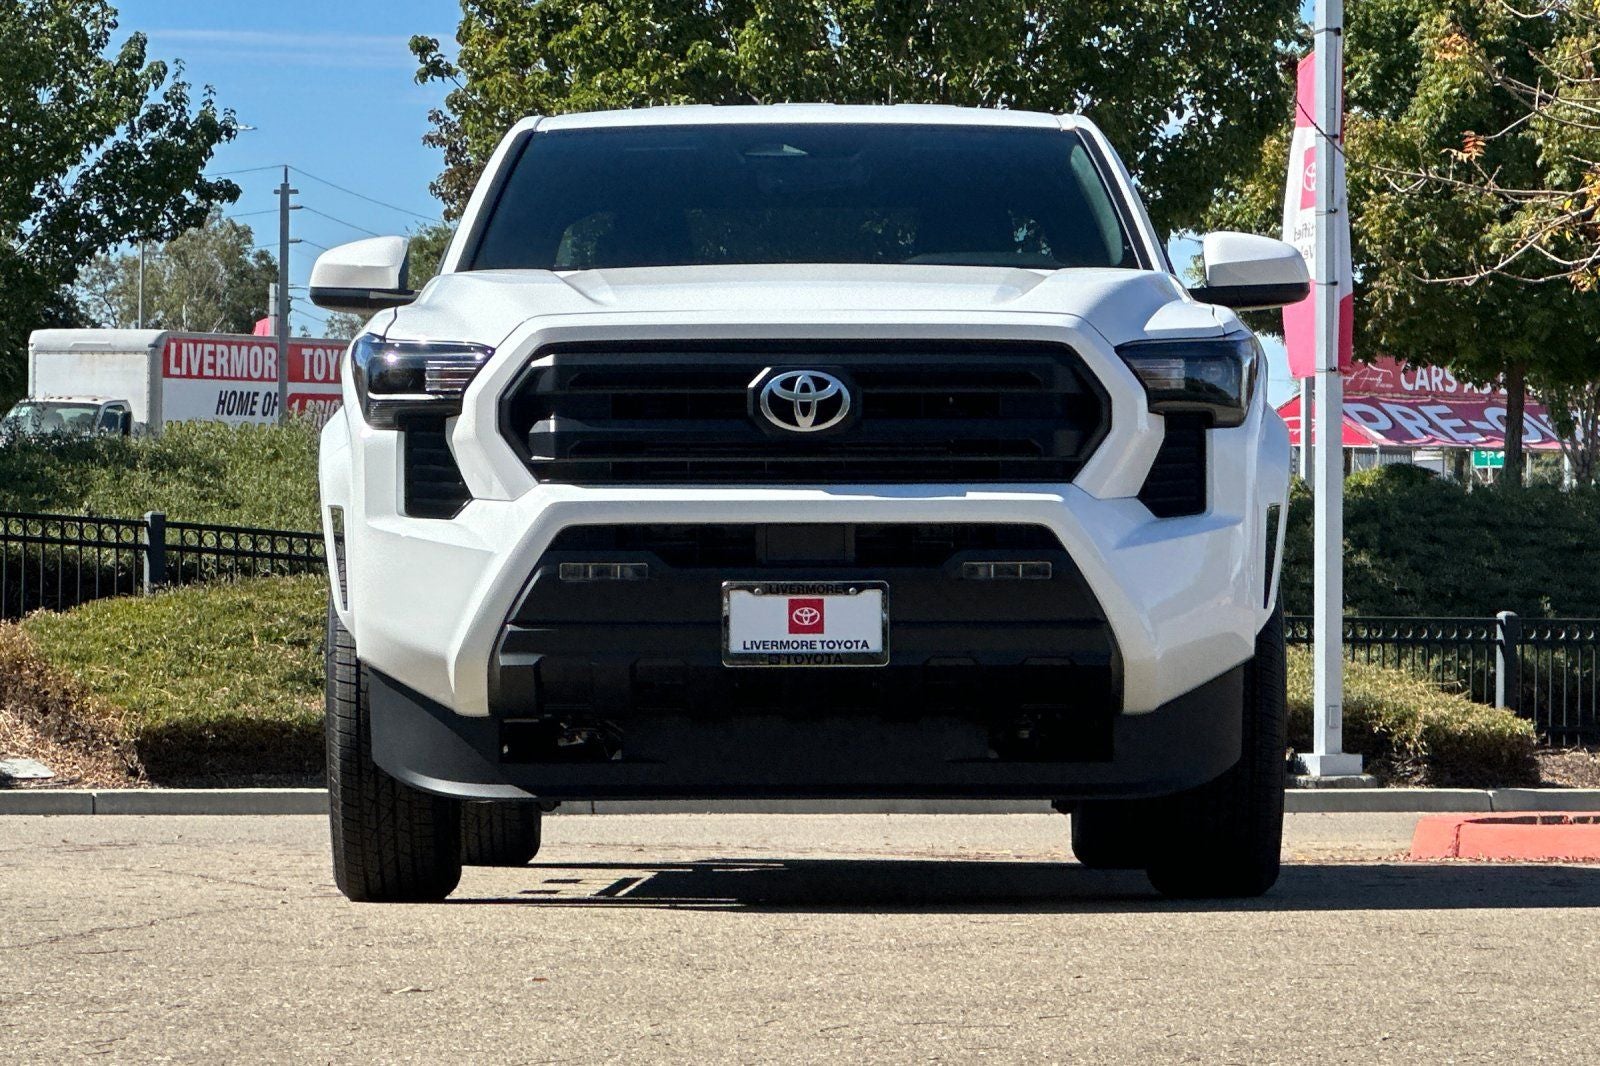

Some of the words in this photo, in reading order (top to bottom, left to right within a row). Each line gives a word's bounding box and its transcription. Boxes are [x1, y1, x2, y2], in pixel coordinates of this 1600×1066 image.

[169, 342, 278, 379] LIVERMOR
[301, 347, 345, 381] TOY
[1401, 362, 1457, 393] CARS
[216, 390, 259, 416] HOME
[769, 584, 842, 595] LIVERMORE
[743, 640, 817, 650] LIVERMORE
[819, 640, 869, 650] TOYOTA
[786, 654, 843, 664] TOYOTA
